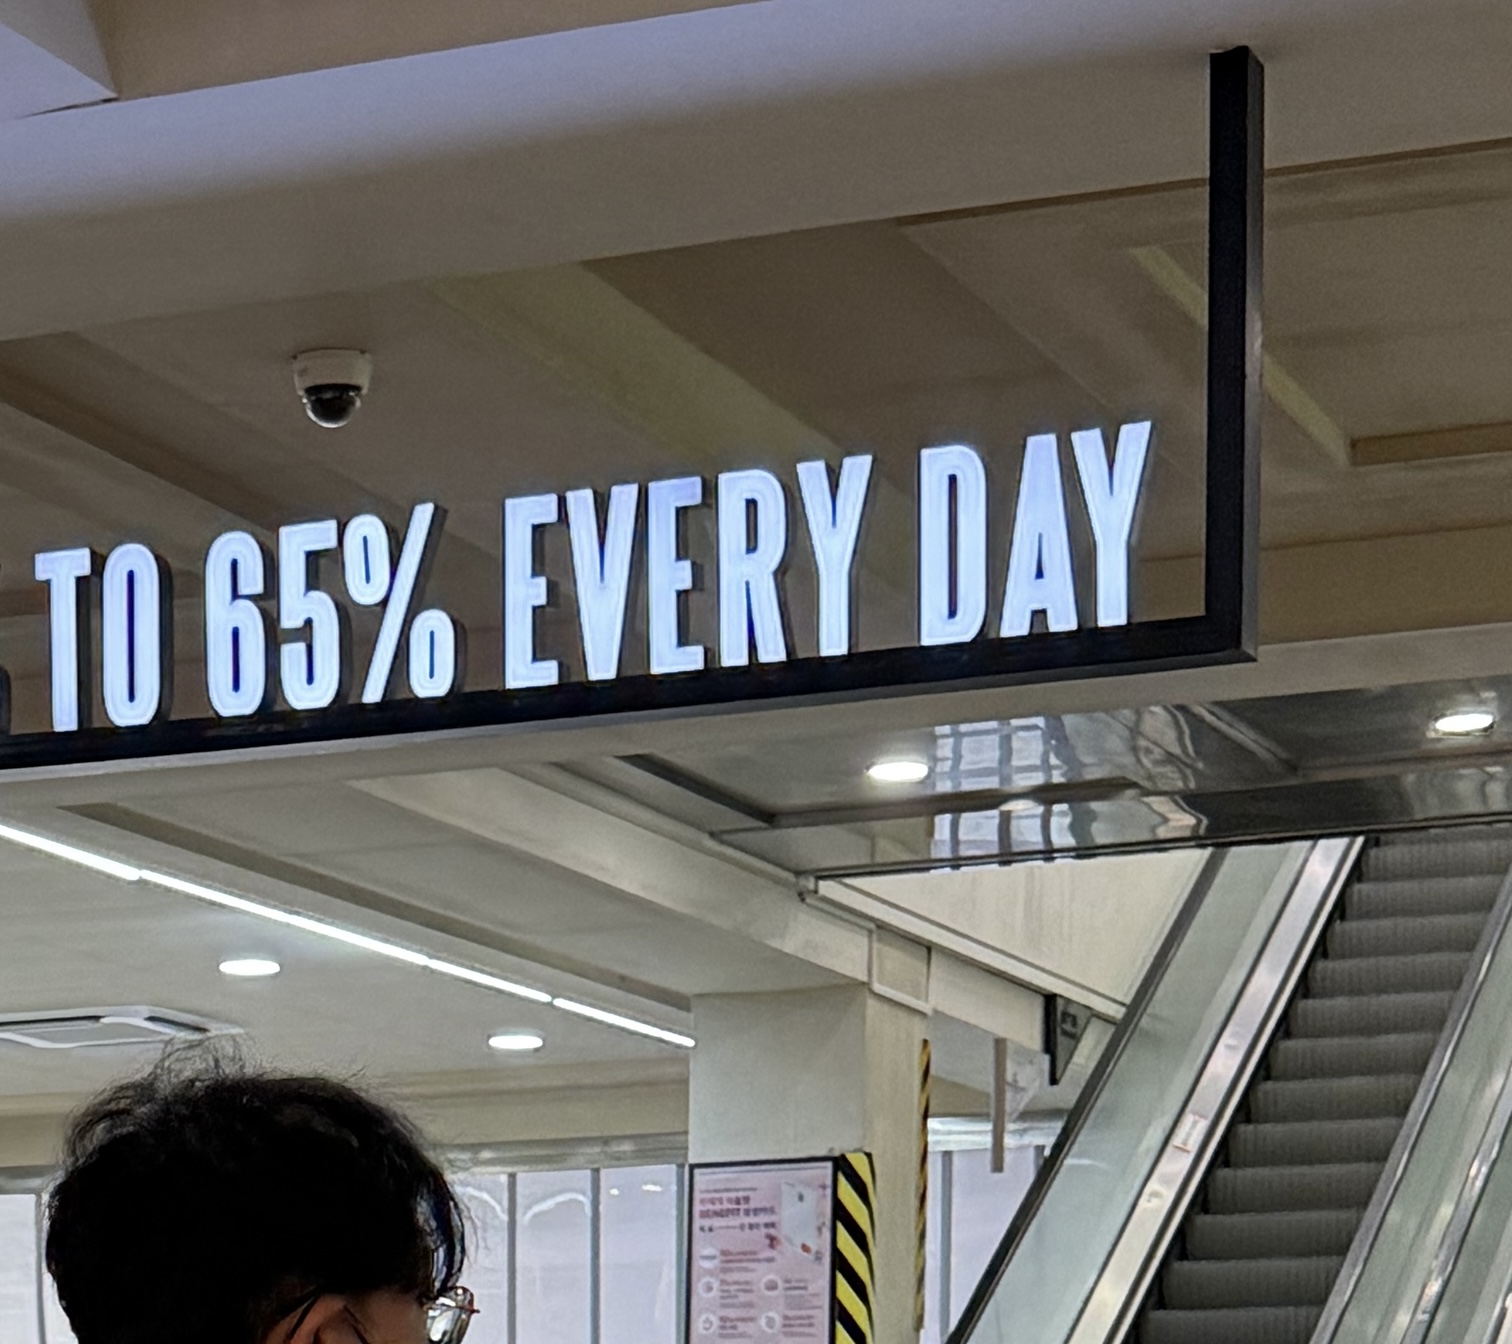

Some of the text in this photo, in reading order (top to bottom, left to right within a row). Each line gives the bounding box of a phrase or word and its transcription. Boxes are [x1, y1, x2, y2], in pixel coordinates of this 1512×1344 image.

[34, 543, 161, 732] TO
[205, 502, 456, 717] 65%
[504, 454, 874, 689] EVERY
[920, 420, 1153, 646] DAY
